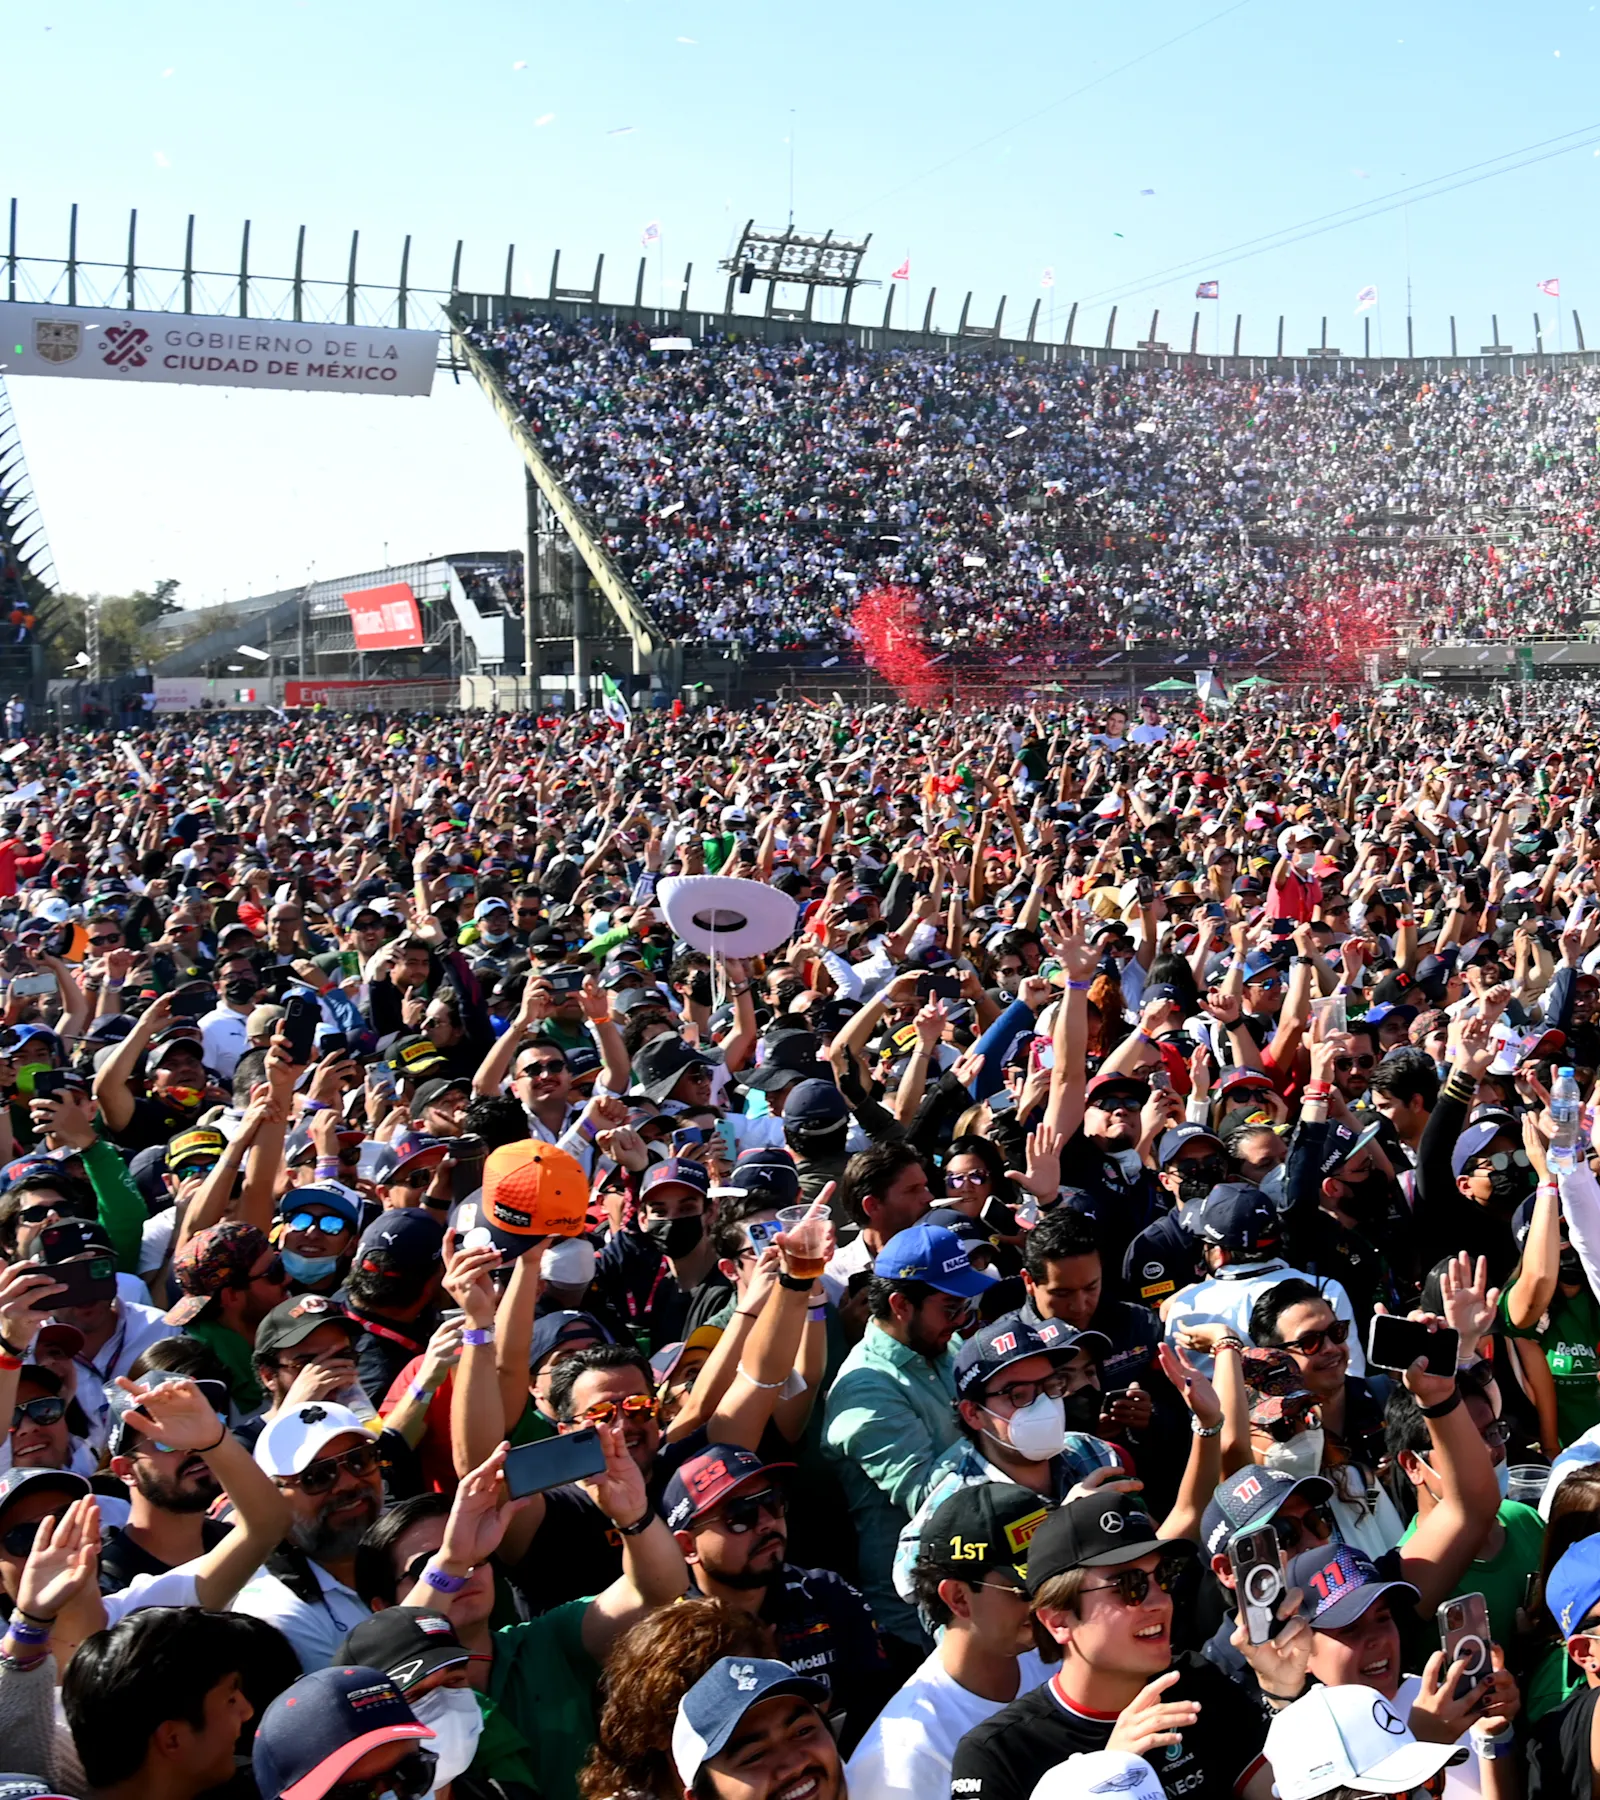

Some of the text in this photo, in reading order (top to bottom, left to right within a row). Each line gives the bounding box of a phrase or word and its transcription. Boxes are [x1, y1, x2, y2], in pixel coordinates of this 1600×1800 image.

[165, 331, 399, 360] GOBIERNO DE LA
[163, 354, 398, 381] CIUDAD DE MÉXICO
[394, 1142, 411, 1158] 11
[1143, 1284, 1172, 1297] PIRELLI
[990, 1331, 1017, 1355] 11
[1037, 1325, 1060, 1343] 11
[958, 1363, 981, 1391] KAVAK
[694, 1459, 728, 1493] 33
[1232, 1475, 1263, 1504] 11
[949, 1535, 988, 1561] 1ST
[1309, 1561, 1345, 1599] 11
[791, 1652, 827, 1672] Mobil
[951, 1778, 982, 1795] PSON
[1165, 1769, 1204, 1799] NEOS
